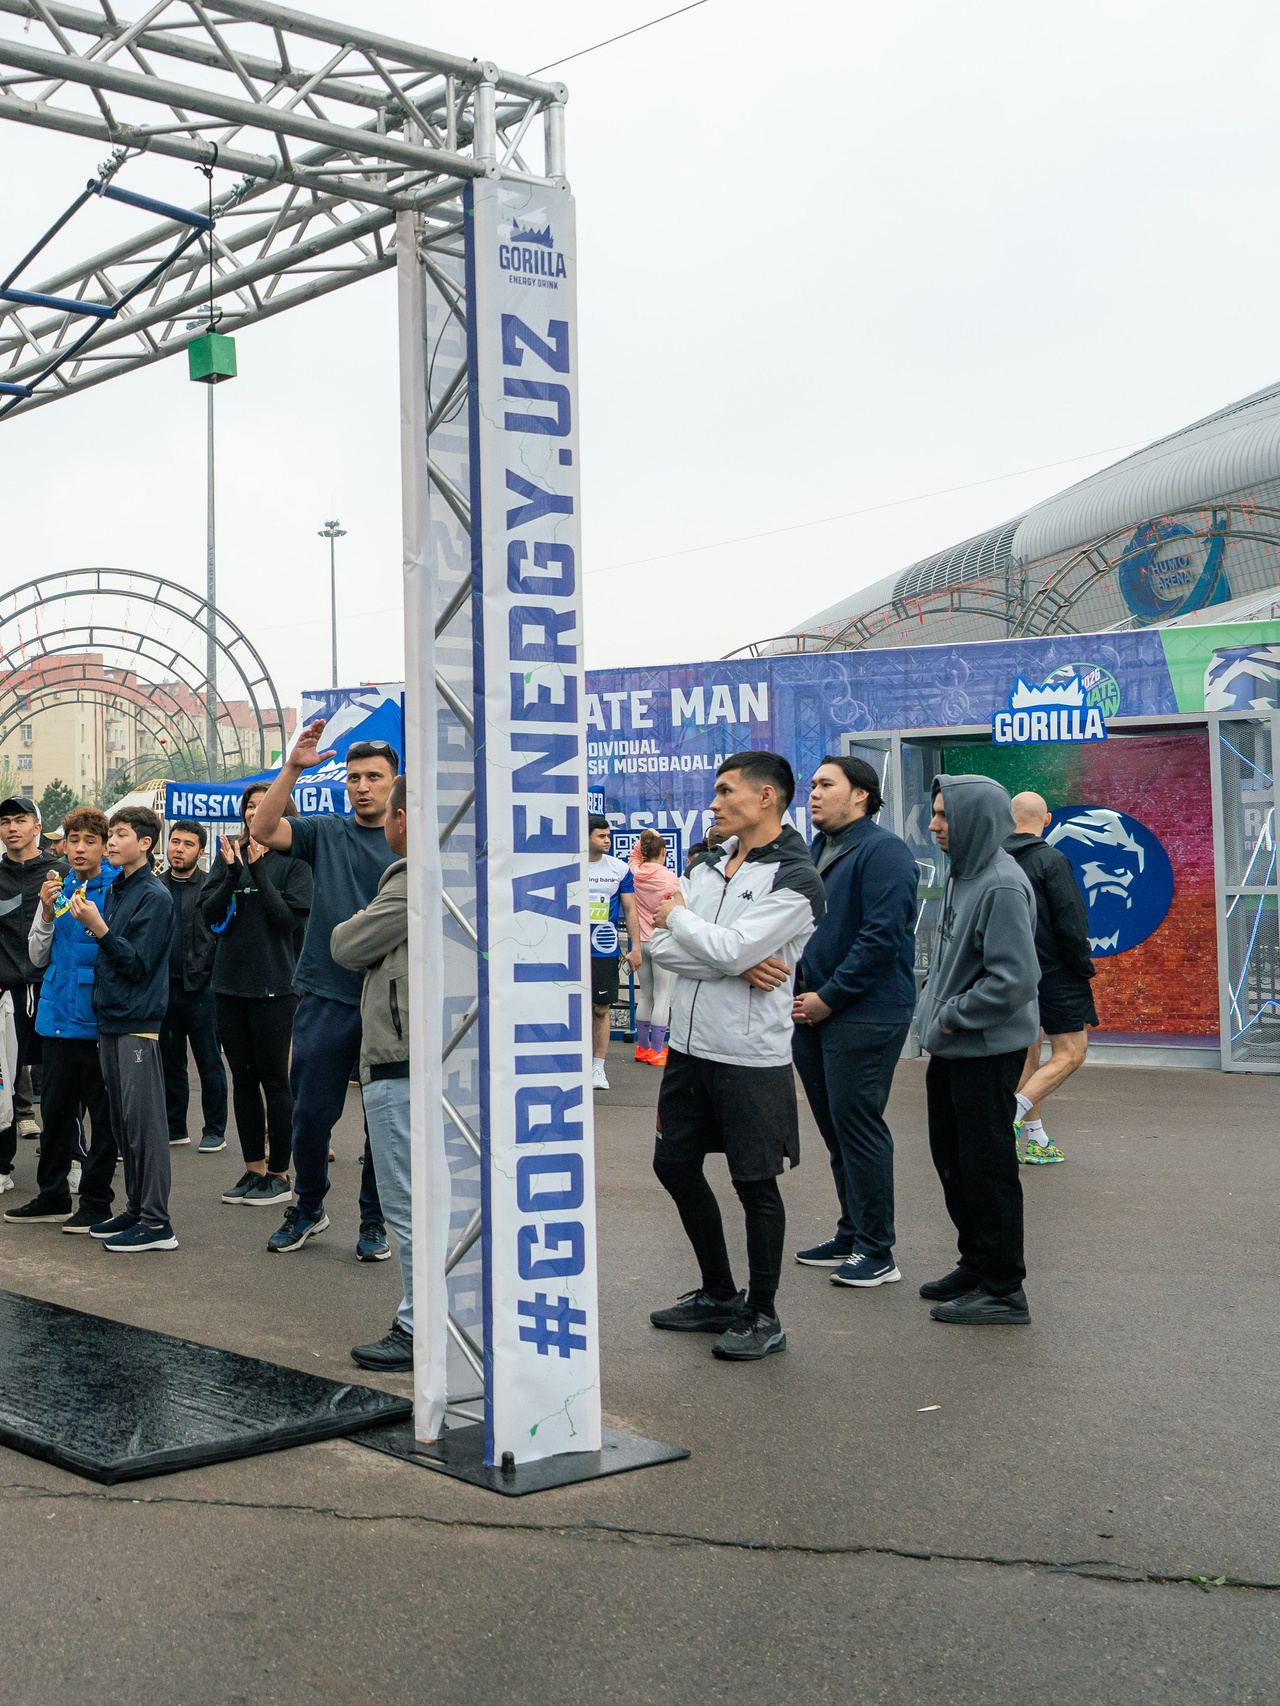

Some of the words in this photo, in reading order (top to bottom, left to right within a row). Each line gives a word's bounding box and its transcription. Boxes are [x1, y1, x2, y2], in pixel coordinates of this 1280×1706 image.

[499, 244, 567, 279] GORILLA
[508, 275, 536, 288] ENERGY
[537, 279, 559, 290] DRINK
[1151, 555, 1190, 575] HUMO
[1156, 571, 1192, 590] ARENA
[671, 682, 769, 727] MAN
[995, 708, 1104, 743] GORILLA
[587, 739, 660, 758] DIVIDUAL
[614, 753, 733, 774] MUSOBAQALA
[501, 313, 587, 1360] #GORILLAENERGY.UZ
